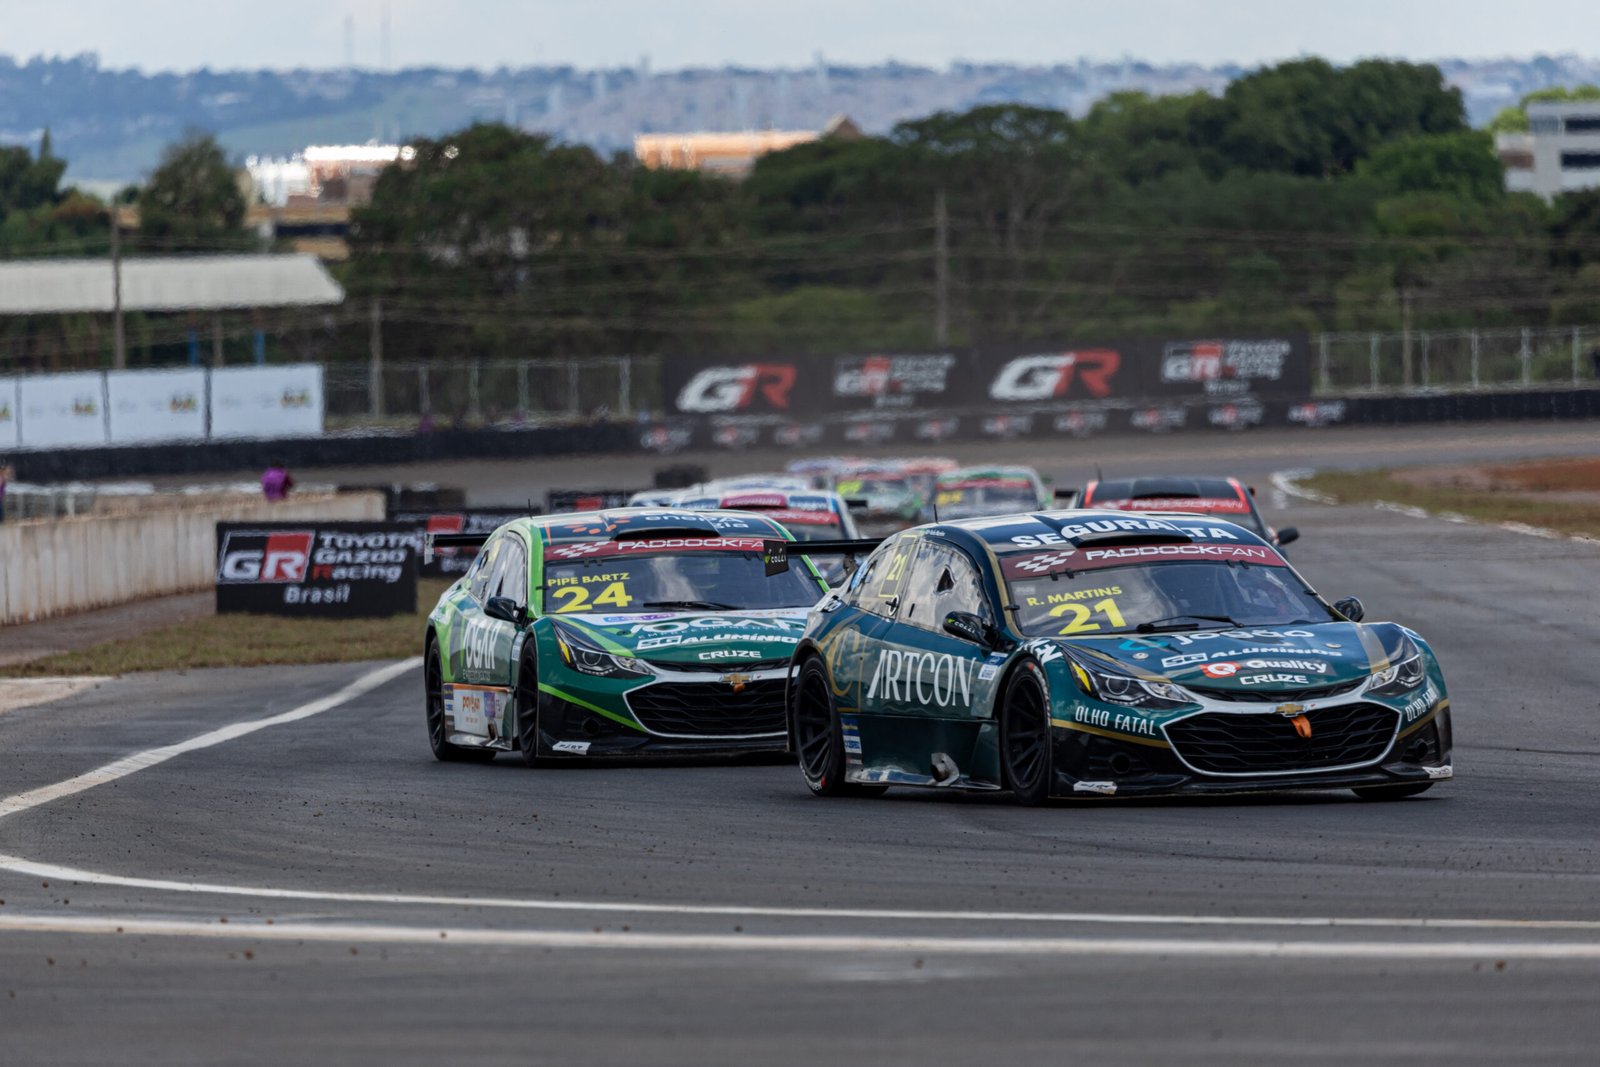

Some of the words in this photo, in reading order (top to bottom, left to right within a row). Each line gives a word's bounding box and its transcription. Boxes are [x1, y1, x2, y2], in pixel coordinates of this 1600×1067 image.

[989, 349, 1120, 399] GR
[675, 364, 796, 412] GR
[319, 531, 415, 549] TOYOTA
[618, 538, 765, 550] PADDOCKFA
[313, 549, 407, 565] GAZOO
[770, 555, 787, 564] COLLI
[1086, 545, 1265, 561] PADDOCKFAN
[223, 551, 307, 579] GR
[311, 564, 402, 582] Racing
[886, 553, 907, 581] 21
[547, 577, 579, 587] PIPE
[582, 572, 631, 584] BARTZ
[284, 584, 350, 603] Brasil
[552, 582, 633, 613] 24
[1026, 597, 1045, 607] R.
[1049, 586, 1122, 604] MARTINS
[1050, 598, 1127, 635] 21
[954, 621, 976, 634] COLLI
[682, 634, 800, 645] ALUMÍNIO
[698, 650, 762, 660] CRUZE
[1246, 660, 1327, 673] Quality
[867, 649, 976, 707] ARTCON
[1240, 674, 1309, 685] CRUZE
[1075, 705, 1110, 727] OLHO
[1114, 714, 1156, 736] FATAL
